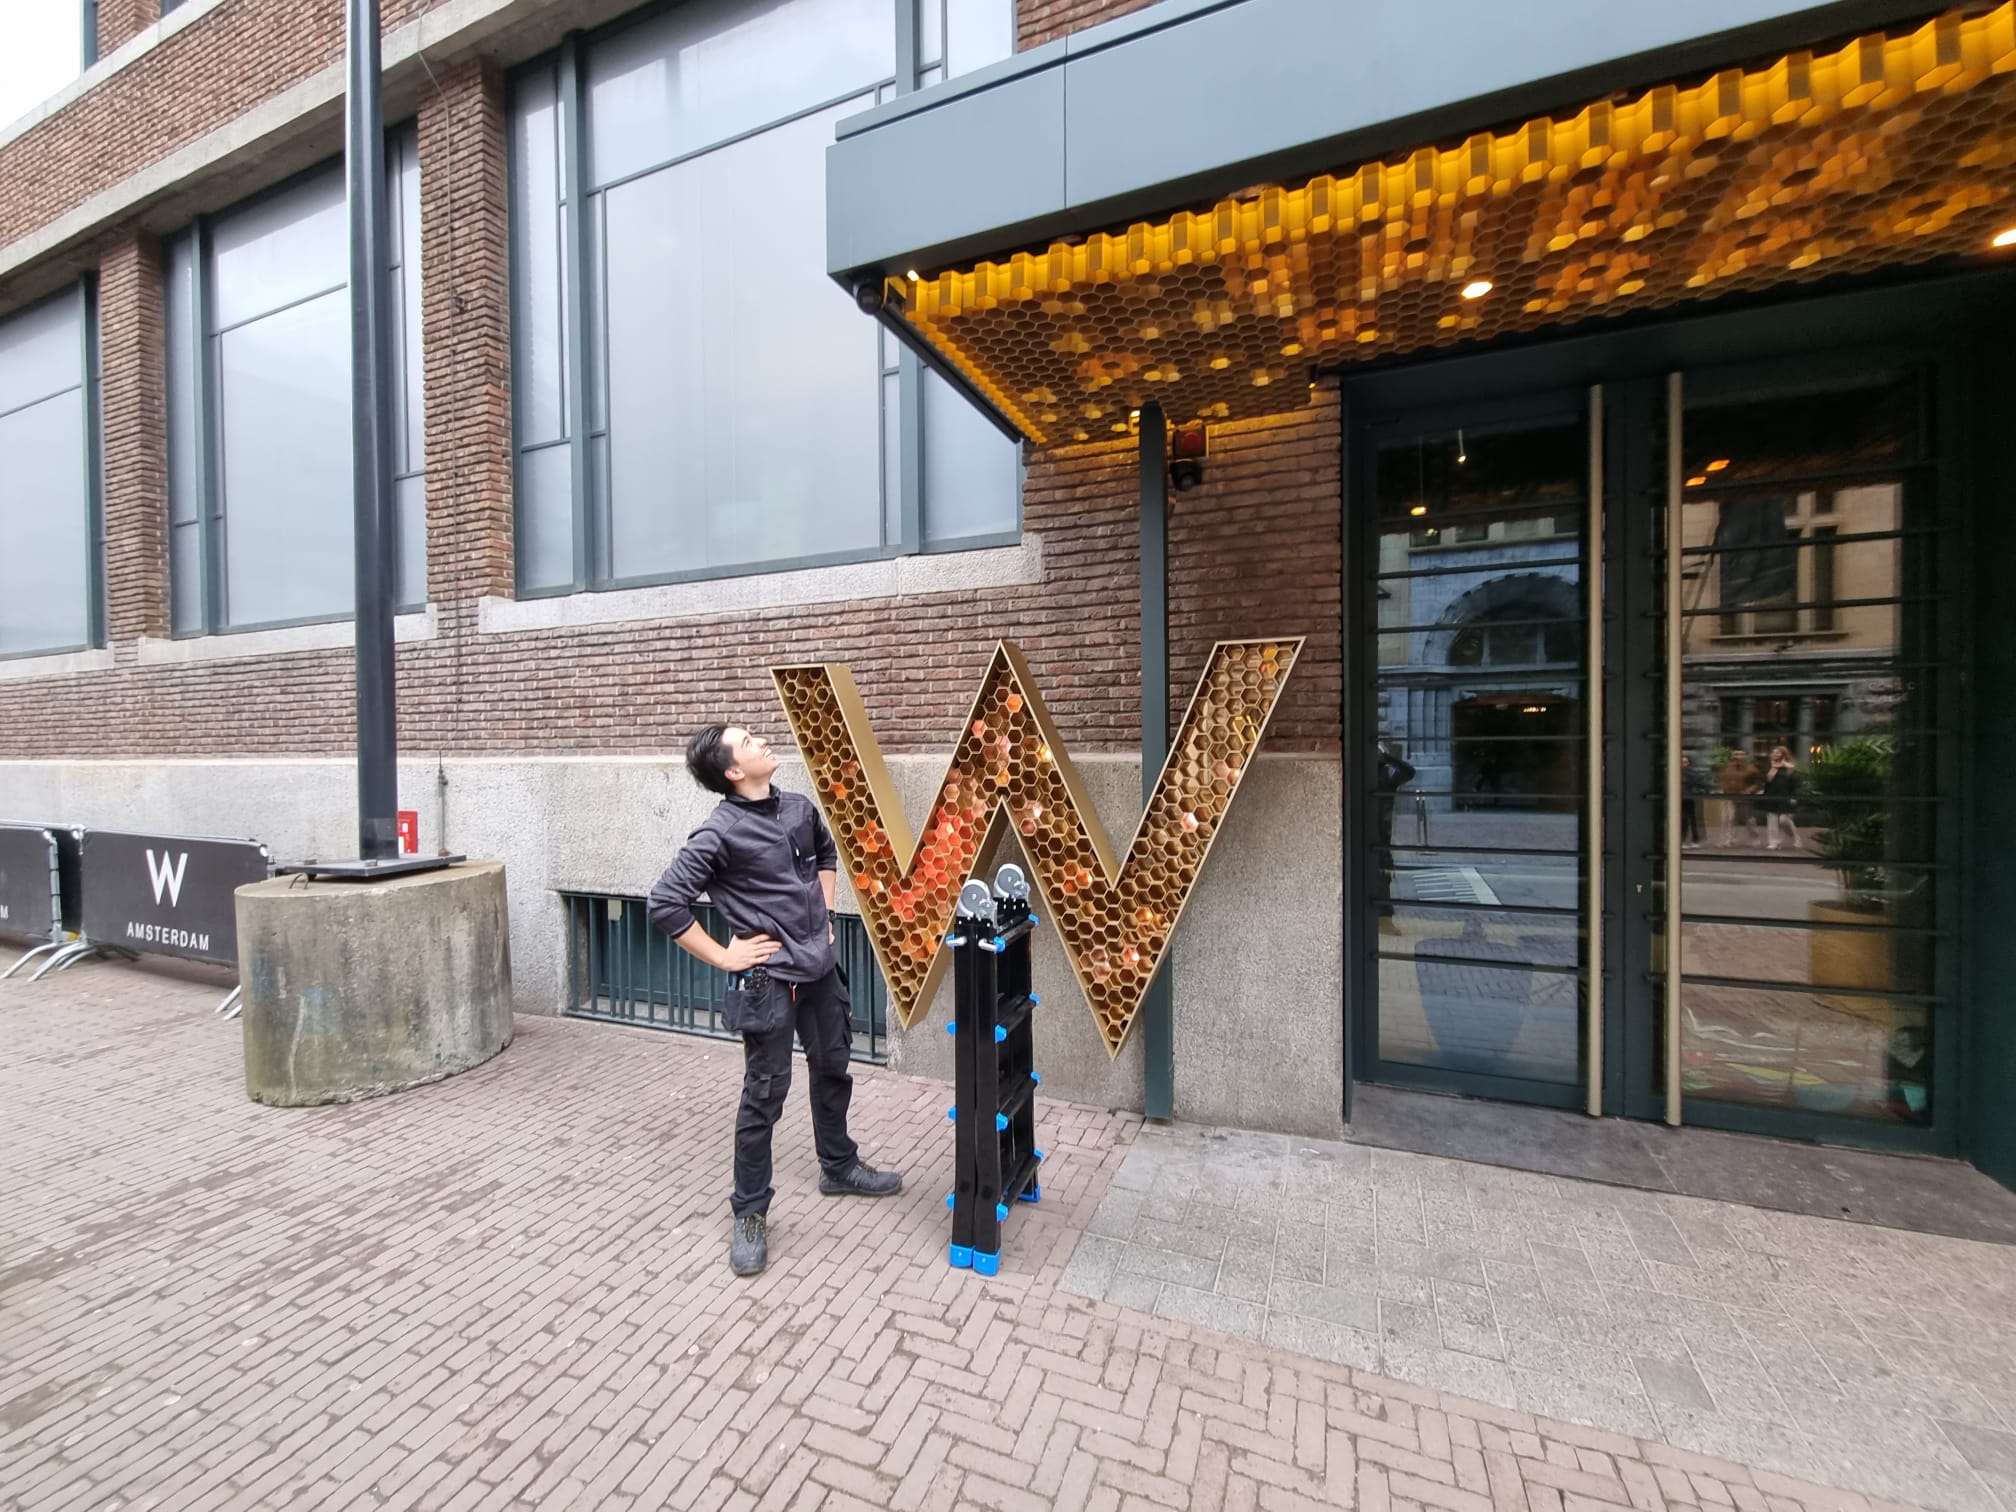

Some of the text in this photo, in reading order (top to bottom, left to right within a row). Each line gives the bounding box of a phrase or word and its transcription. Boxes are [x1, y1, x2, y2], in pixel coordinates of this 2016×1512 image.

[146, 849, 188, 908] W
[769, 636, 1306, 1063] W
[126, 921, 209, 951] AMSTERDAM
